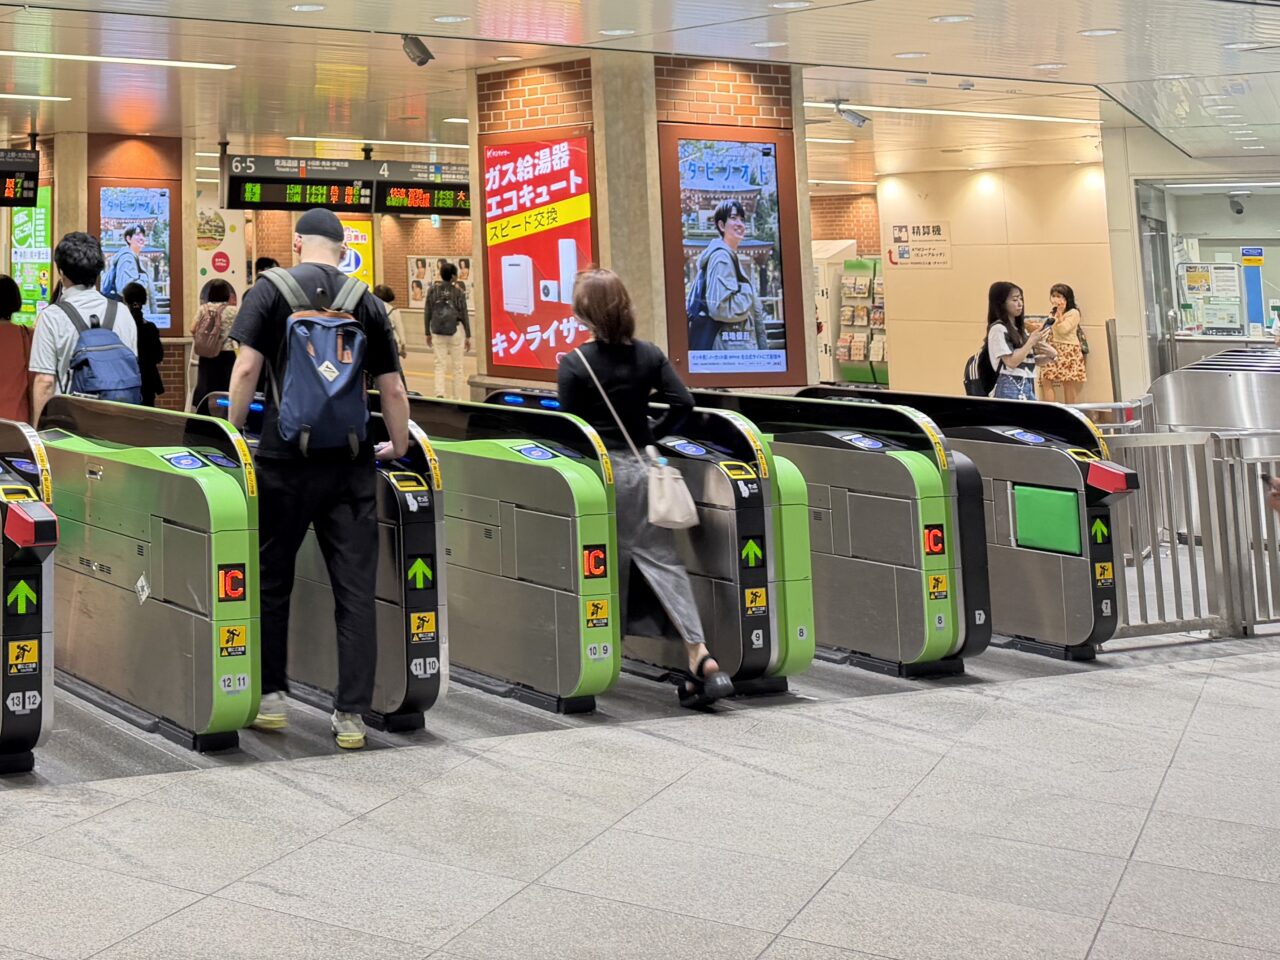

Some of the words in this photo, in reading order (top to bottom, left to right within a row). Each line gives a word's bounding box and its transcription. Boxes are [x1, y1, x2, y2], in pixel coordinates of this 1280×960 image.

[379, 162, 390, 178] 4
[485, 141, 570, 191] ガス給湯器
[688, 162, 767, 182] タビノオト
[486, 169, 583, 218] エコキュート
[490, 207, 559, 242] スピード交換
[912, 225, 942, 236] 精算機
[924, 529, 943, 553] IC
[583, 550, 605, 576] IC
[218, 570, 244, 598] IC
[755, 632, 761, 642] 9
[798, 628, 804, 638] 8
[589, 646, 597, 656] 10
[602, 644, 608, 655] 9
[414, 661, 422, 672] 11
[428, 660, 436, 671] 10
[222, 677, 232, 688] 12
[237, 676, 246, 687] 11
[11, 695, 21, 707] 13
[27, 694, 37, 706] 12
